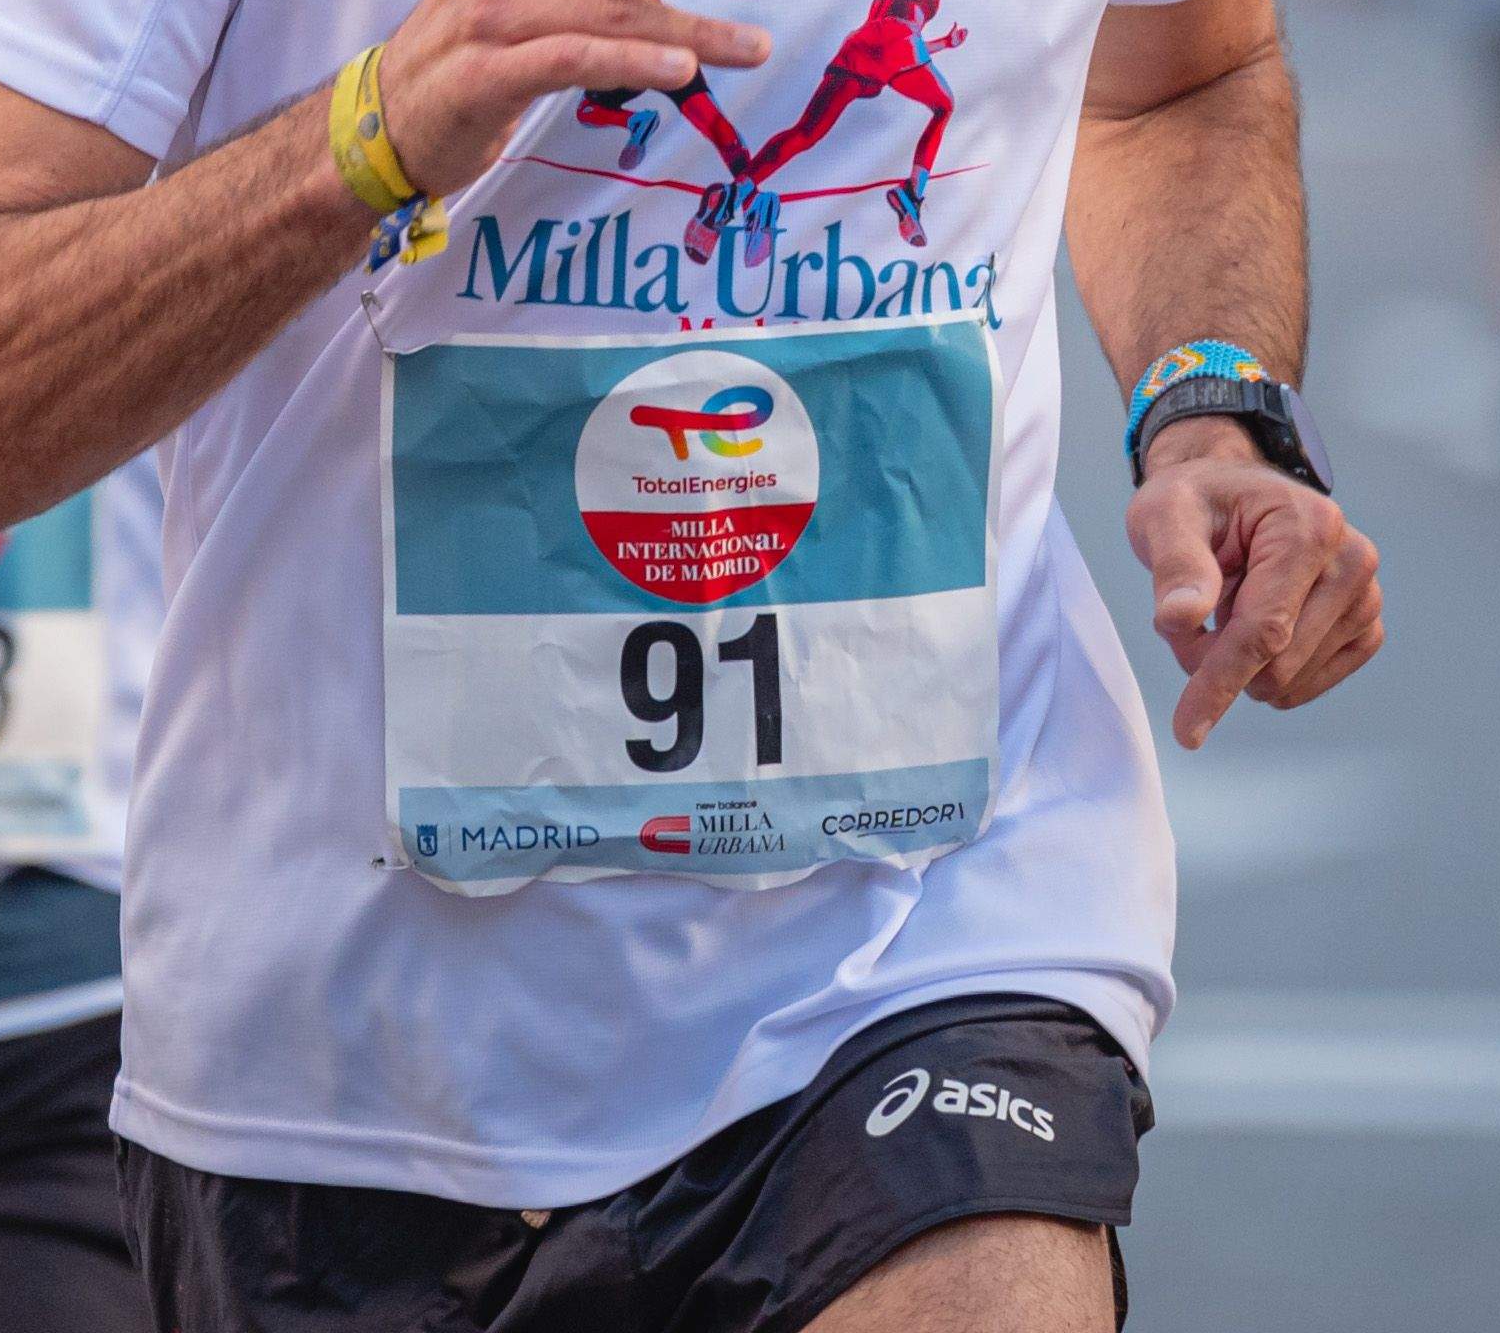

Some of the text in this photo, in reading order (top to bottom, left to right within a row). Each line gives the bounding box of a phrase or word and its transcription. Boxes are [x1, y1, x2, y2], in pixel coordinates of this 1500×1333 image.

[456, 208, 1003, 331] Milla Urbana
[631, 470, 778, 495] TotalEnergies
[670, 516, 735, 538] MILLA
[644, 555, 761, 582] DE MADRID
[619, 612, 784, 773] 91
[698, 812, 774, 833] MILLA
[461, 825, 601, 852] MADRID
[697, 833, 786, 855] URBANA
[932, 1078, 1055, 1142] asics
